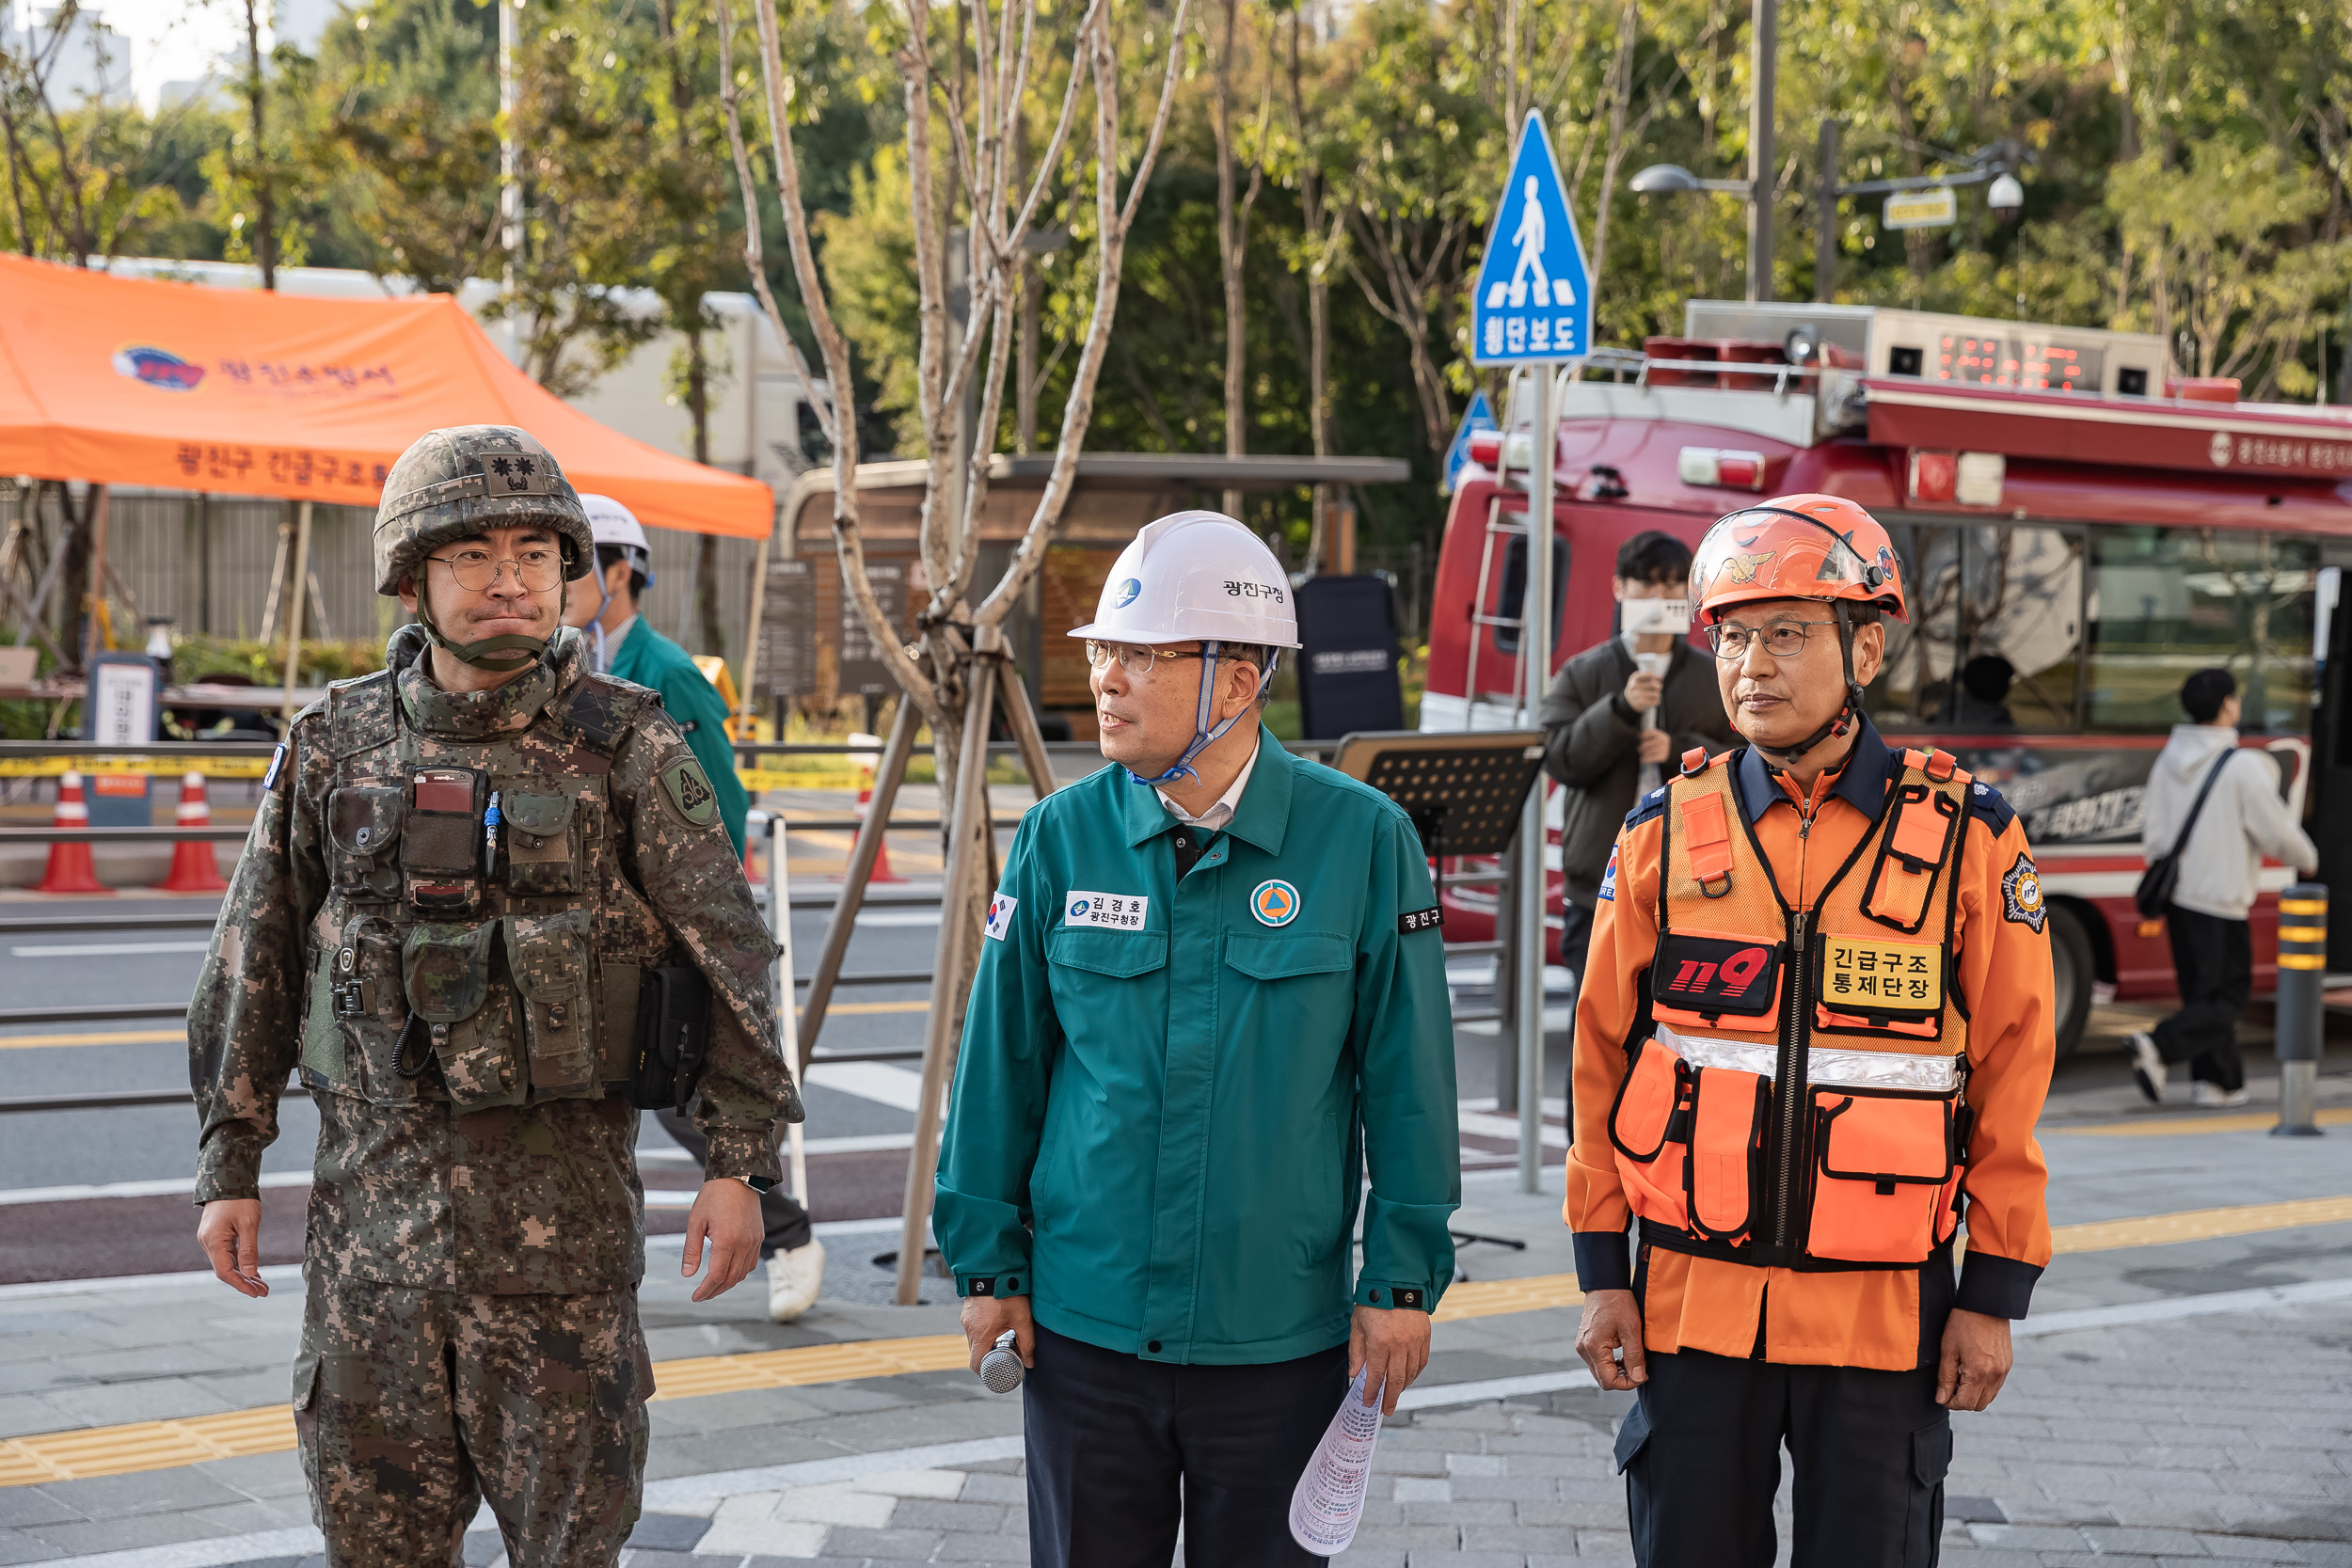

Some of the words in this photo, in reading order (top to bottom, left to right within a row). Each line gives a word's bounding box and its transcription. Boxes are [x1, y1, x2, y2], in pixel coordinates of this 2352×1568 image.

[1483, 315, 1576, 356] 횡단보도
[177, 443, 256, 478] 광진구
[1223, 580, 1284, 604] 광진구청
[2024, 884, 2036, 899] 119
[1090, 911, 1139, 926] 광진구청장
[1406, 910, 1439, 928] 광진구
[1668, 947, 1768, 997] 119
[1834, 947, 1929, 974] 긴급구조
[1833, 973, 1930, 999] 통제단장
